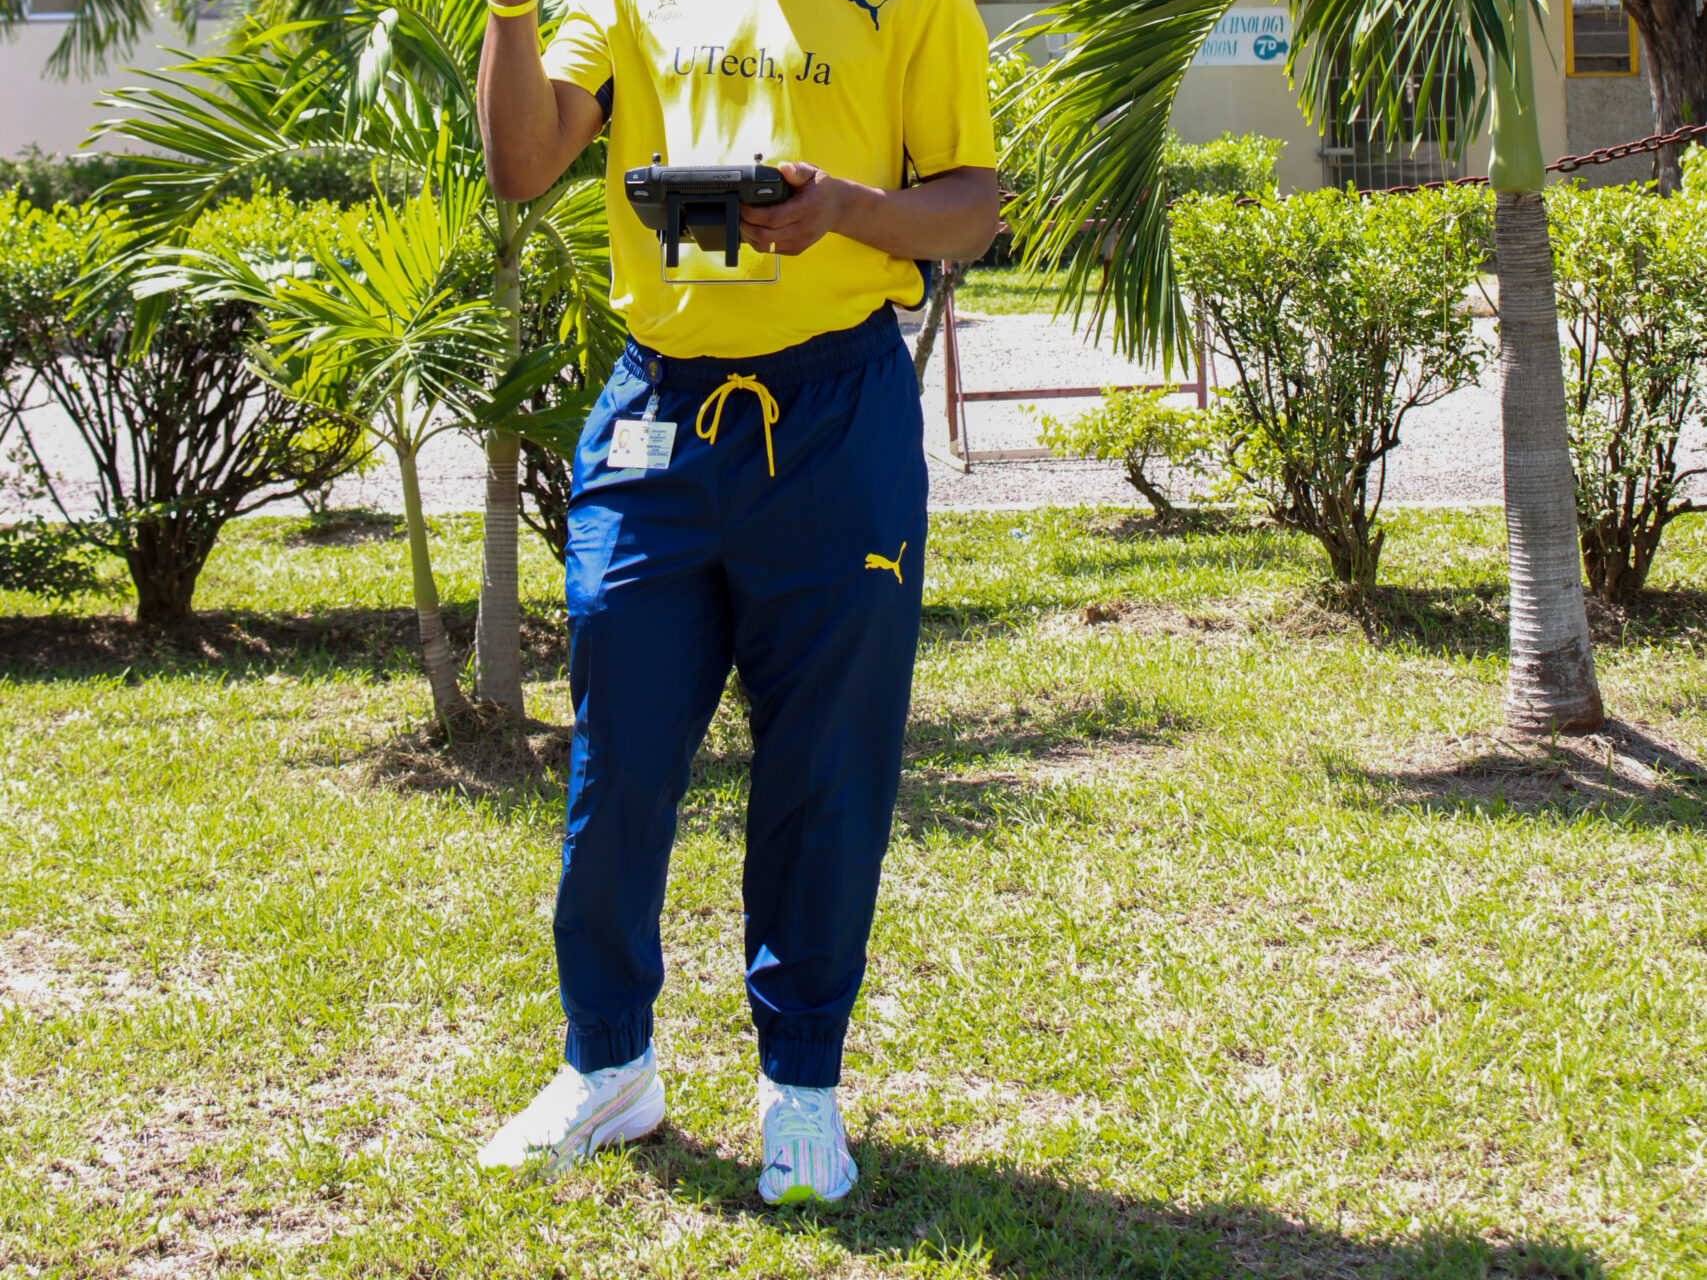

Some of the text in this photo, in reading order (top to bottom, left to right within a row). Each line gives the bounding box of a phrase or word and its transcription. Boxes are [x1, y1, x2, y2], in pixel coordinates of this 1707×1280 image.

[648, 10, 683, 23] Knight
[1214, 16, 1287, 33] ECHNOLOGY
[1202, 40, 1238, 56] ROOM
[673, 46, 831, 86] UTech, Ja
